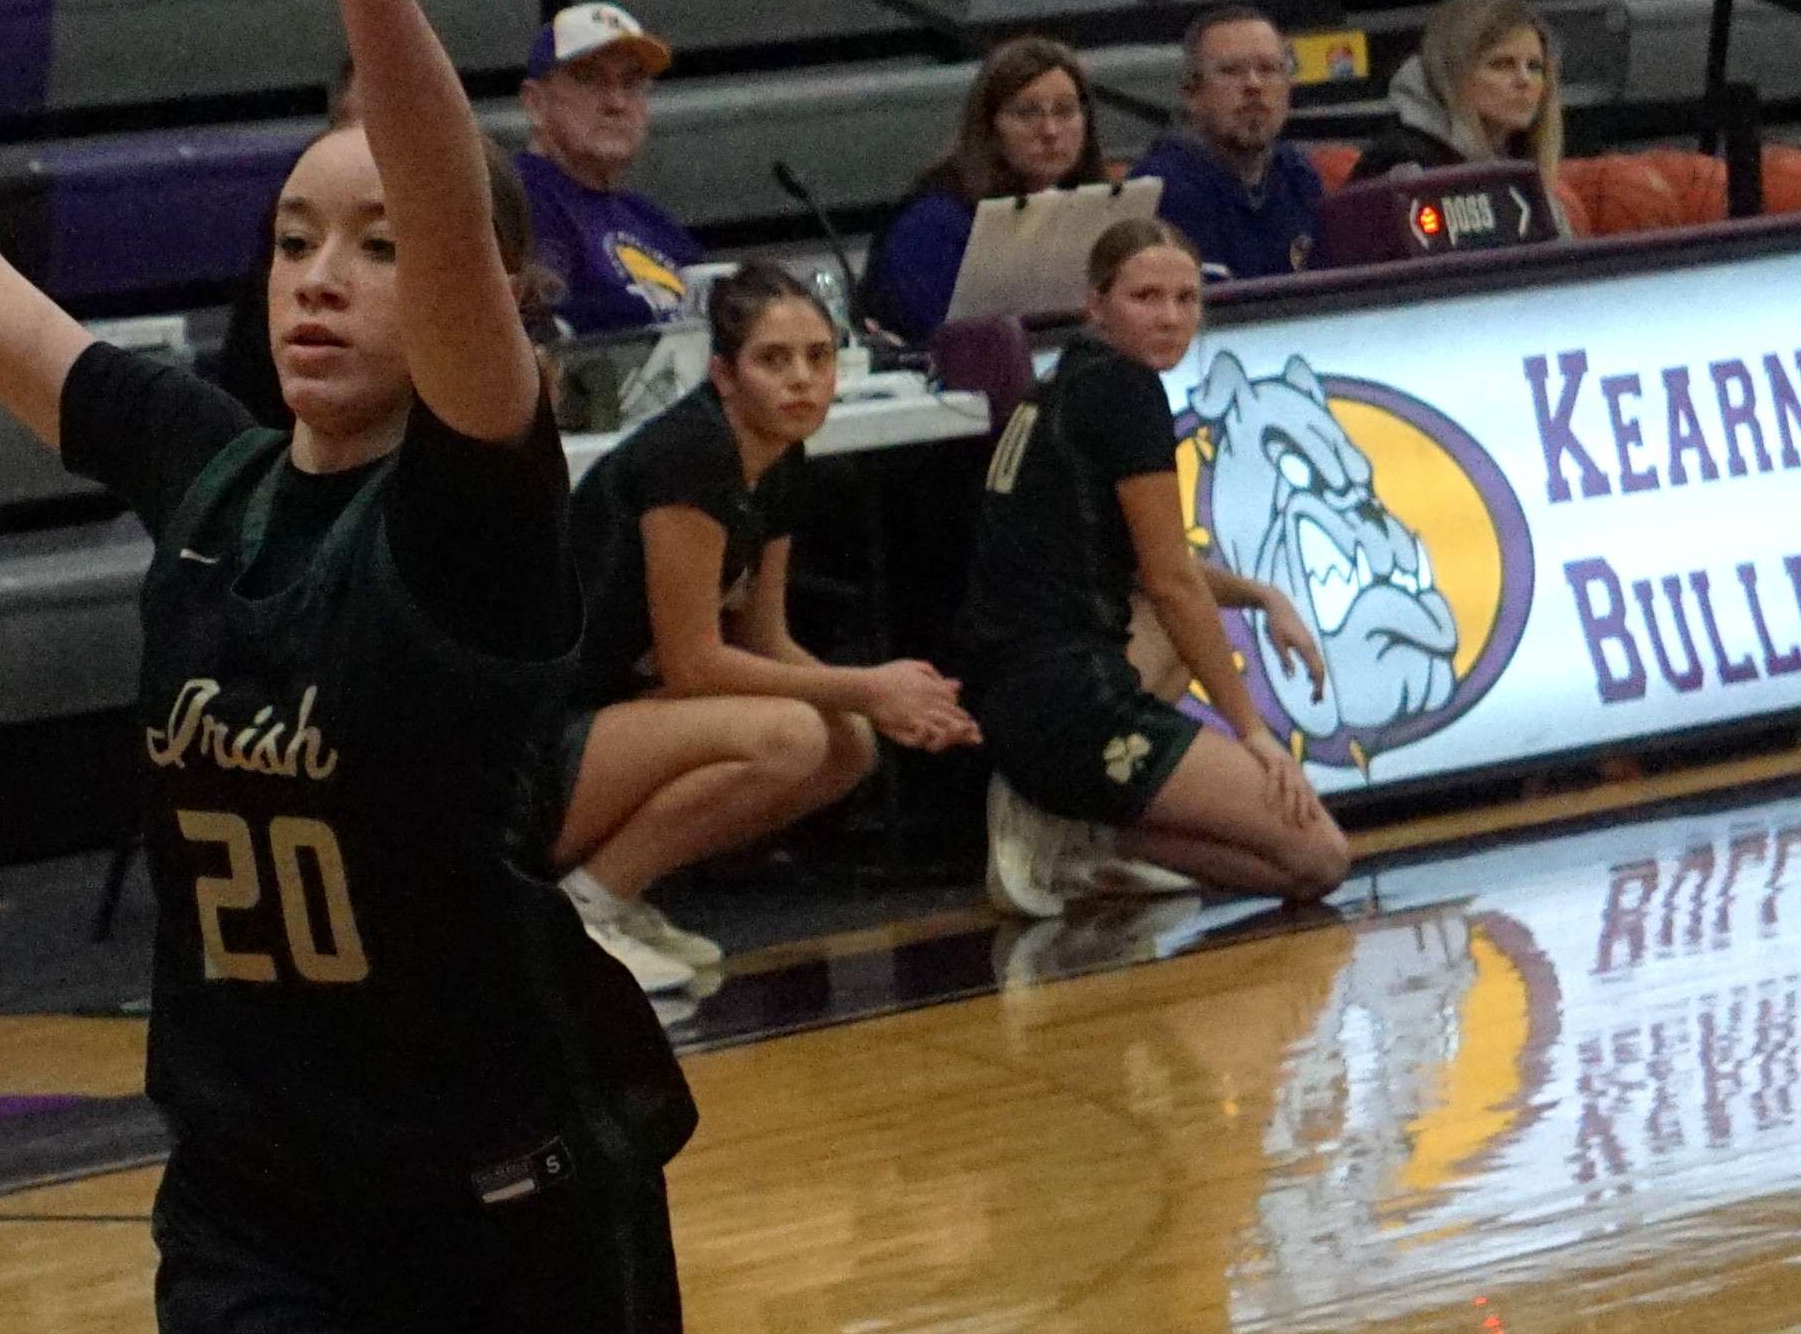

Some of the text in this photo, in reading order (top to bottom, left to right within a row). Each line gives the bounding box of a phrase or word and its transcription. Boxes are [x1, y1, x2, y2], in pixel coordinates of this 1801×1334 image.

[148, 677, 338, 780] Irish
[176, 809, 369, 983] 20
[545, 1154, 561, 1175] S
